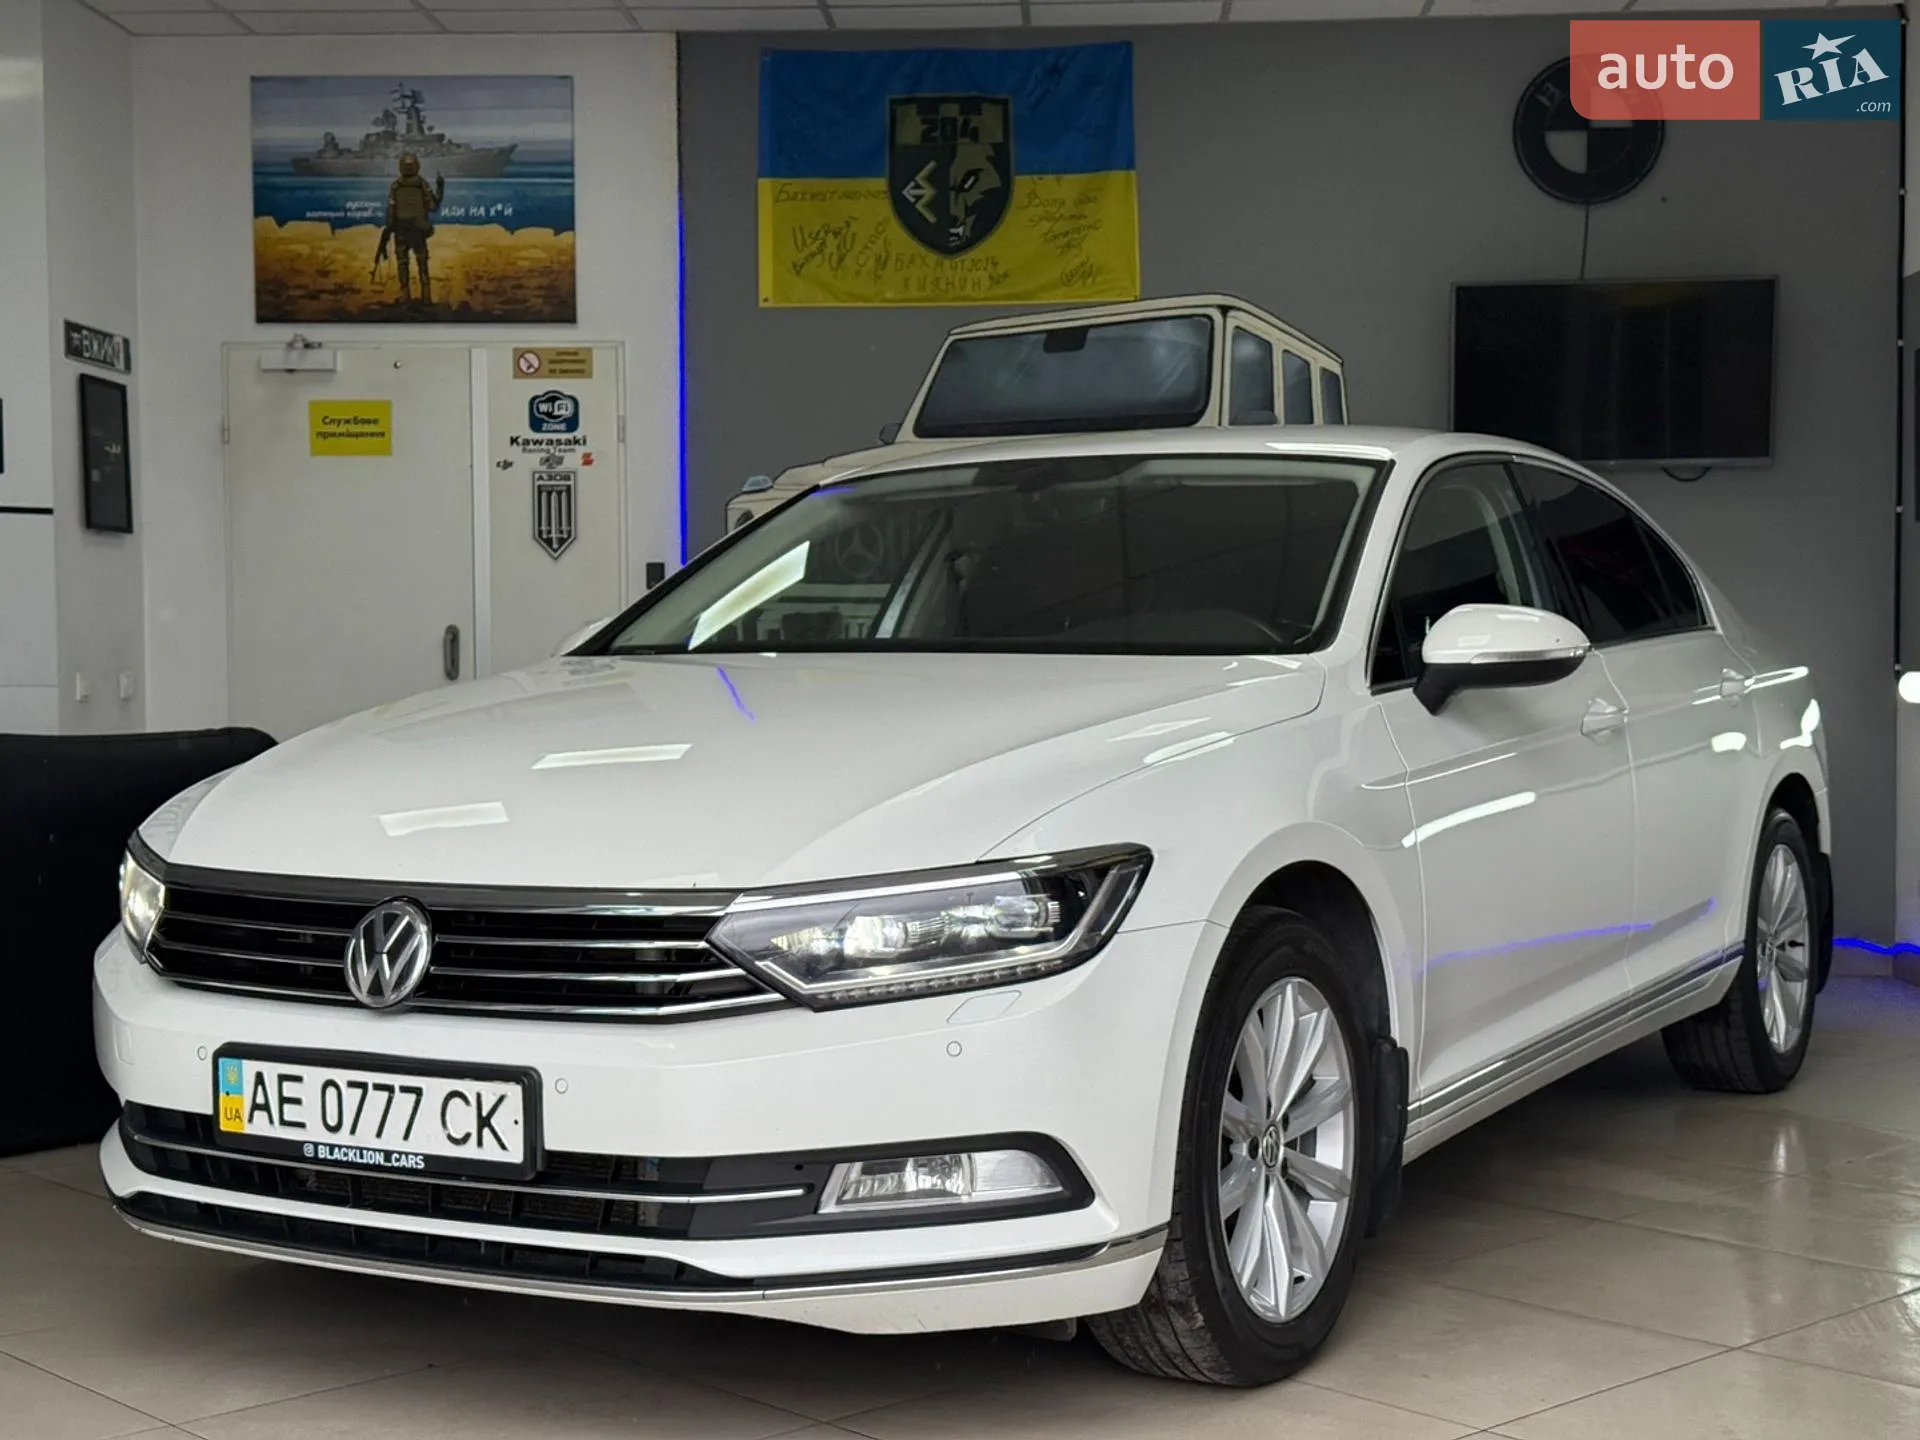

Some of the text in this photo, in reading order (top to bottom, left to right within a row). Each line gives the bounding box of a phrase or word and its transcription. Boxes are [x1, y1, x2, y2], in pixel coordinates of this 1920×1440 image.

[920, 117, 979, 142] 204
[510, 435, 587, 446] Kawasaki
[224, 1107, 243, 1122] UA
[247, 1071, 510, 1151] AE 0777 CK
